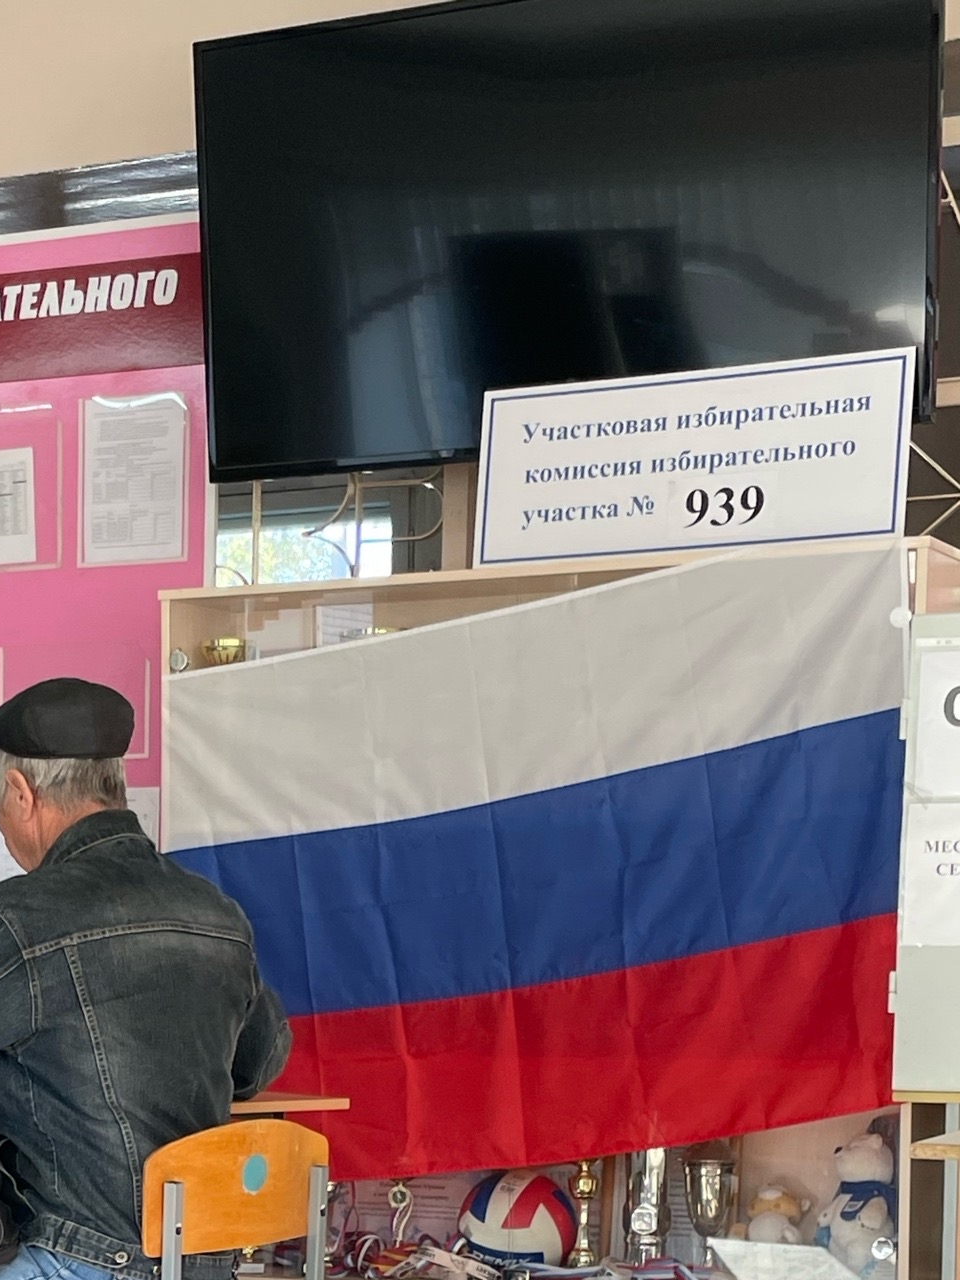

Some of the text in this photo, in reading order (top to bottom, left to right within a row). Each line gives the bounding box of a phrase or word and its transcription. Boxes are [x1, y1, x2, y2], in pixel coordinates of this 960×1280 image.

[522, 395, 871, 444] Участковая избирательная
[525, 440, 856, 485] комиссия избирательного
[522, 485, 765, 531] участка № 939
